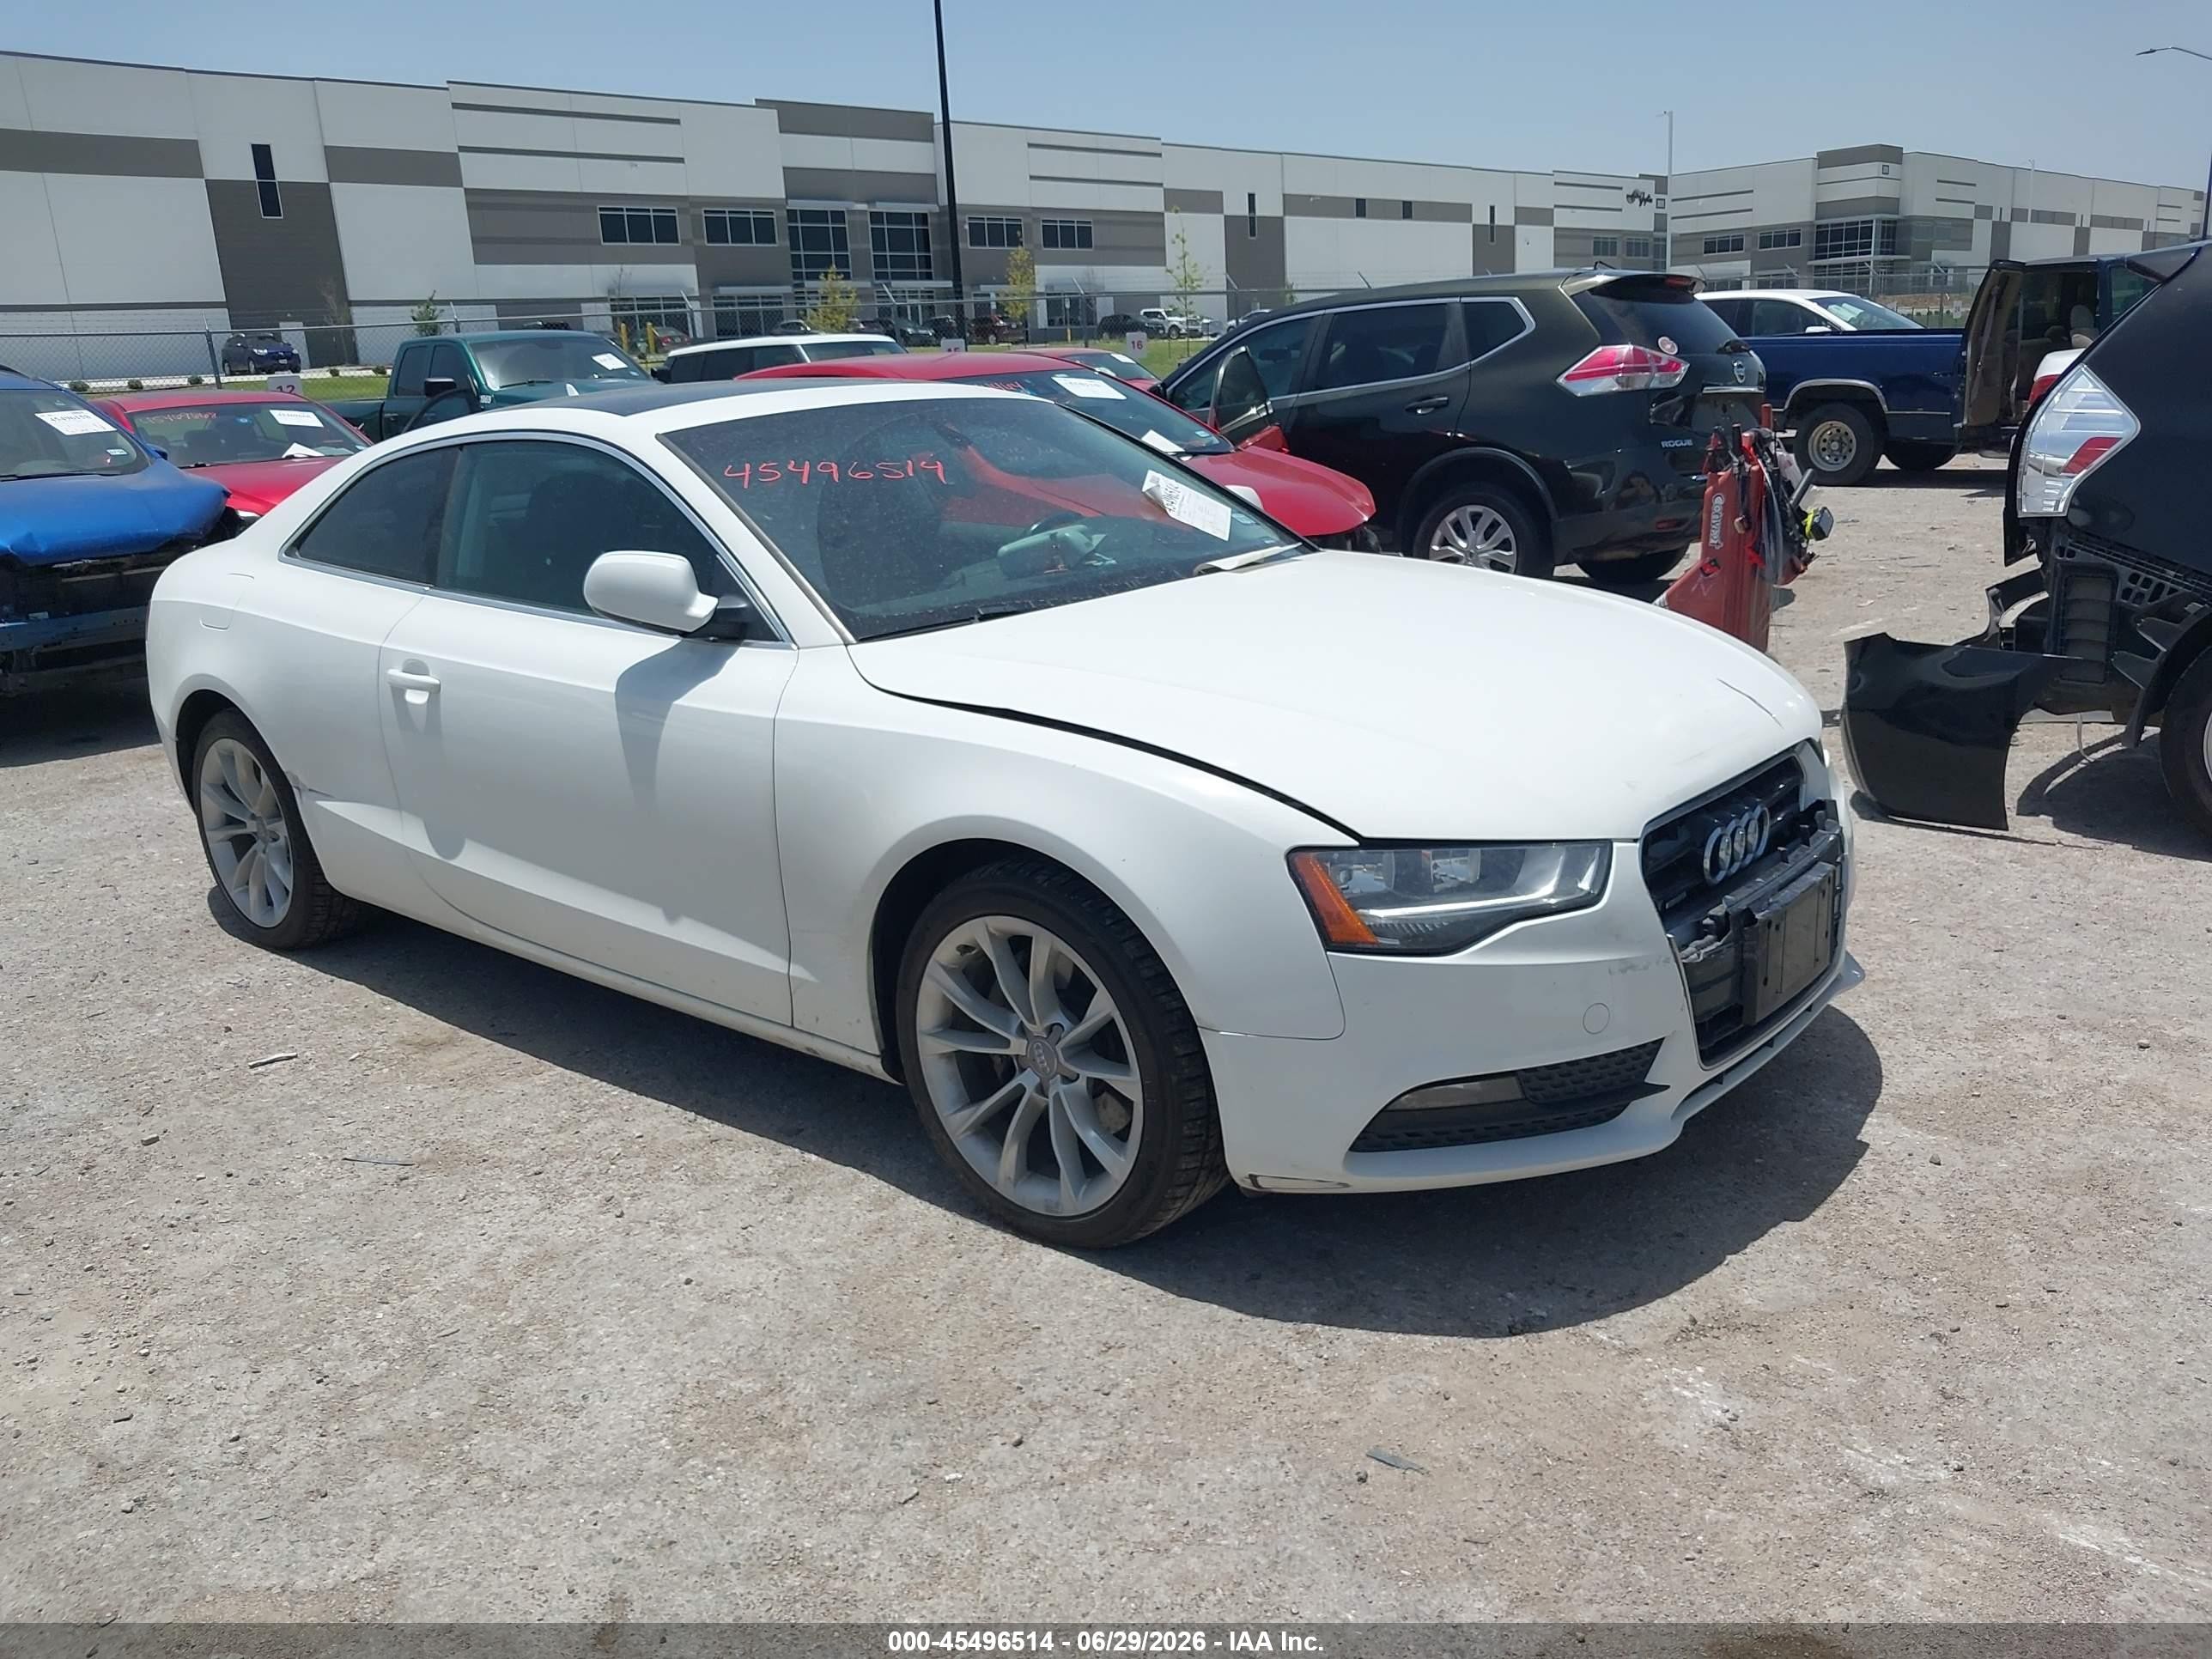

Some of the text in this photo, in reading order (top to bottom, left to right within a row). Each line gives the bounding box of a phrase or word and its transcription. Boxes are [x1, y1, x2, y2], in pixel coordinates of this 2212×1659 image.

[1131, 340, 1144, 350] 16
[1661, 439, 1693, 448] ROGUE
[723, 459, 948, 489] 45496514
